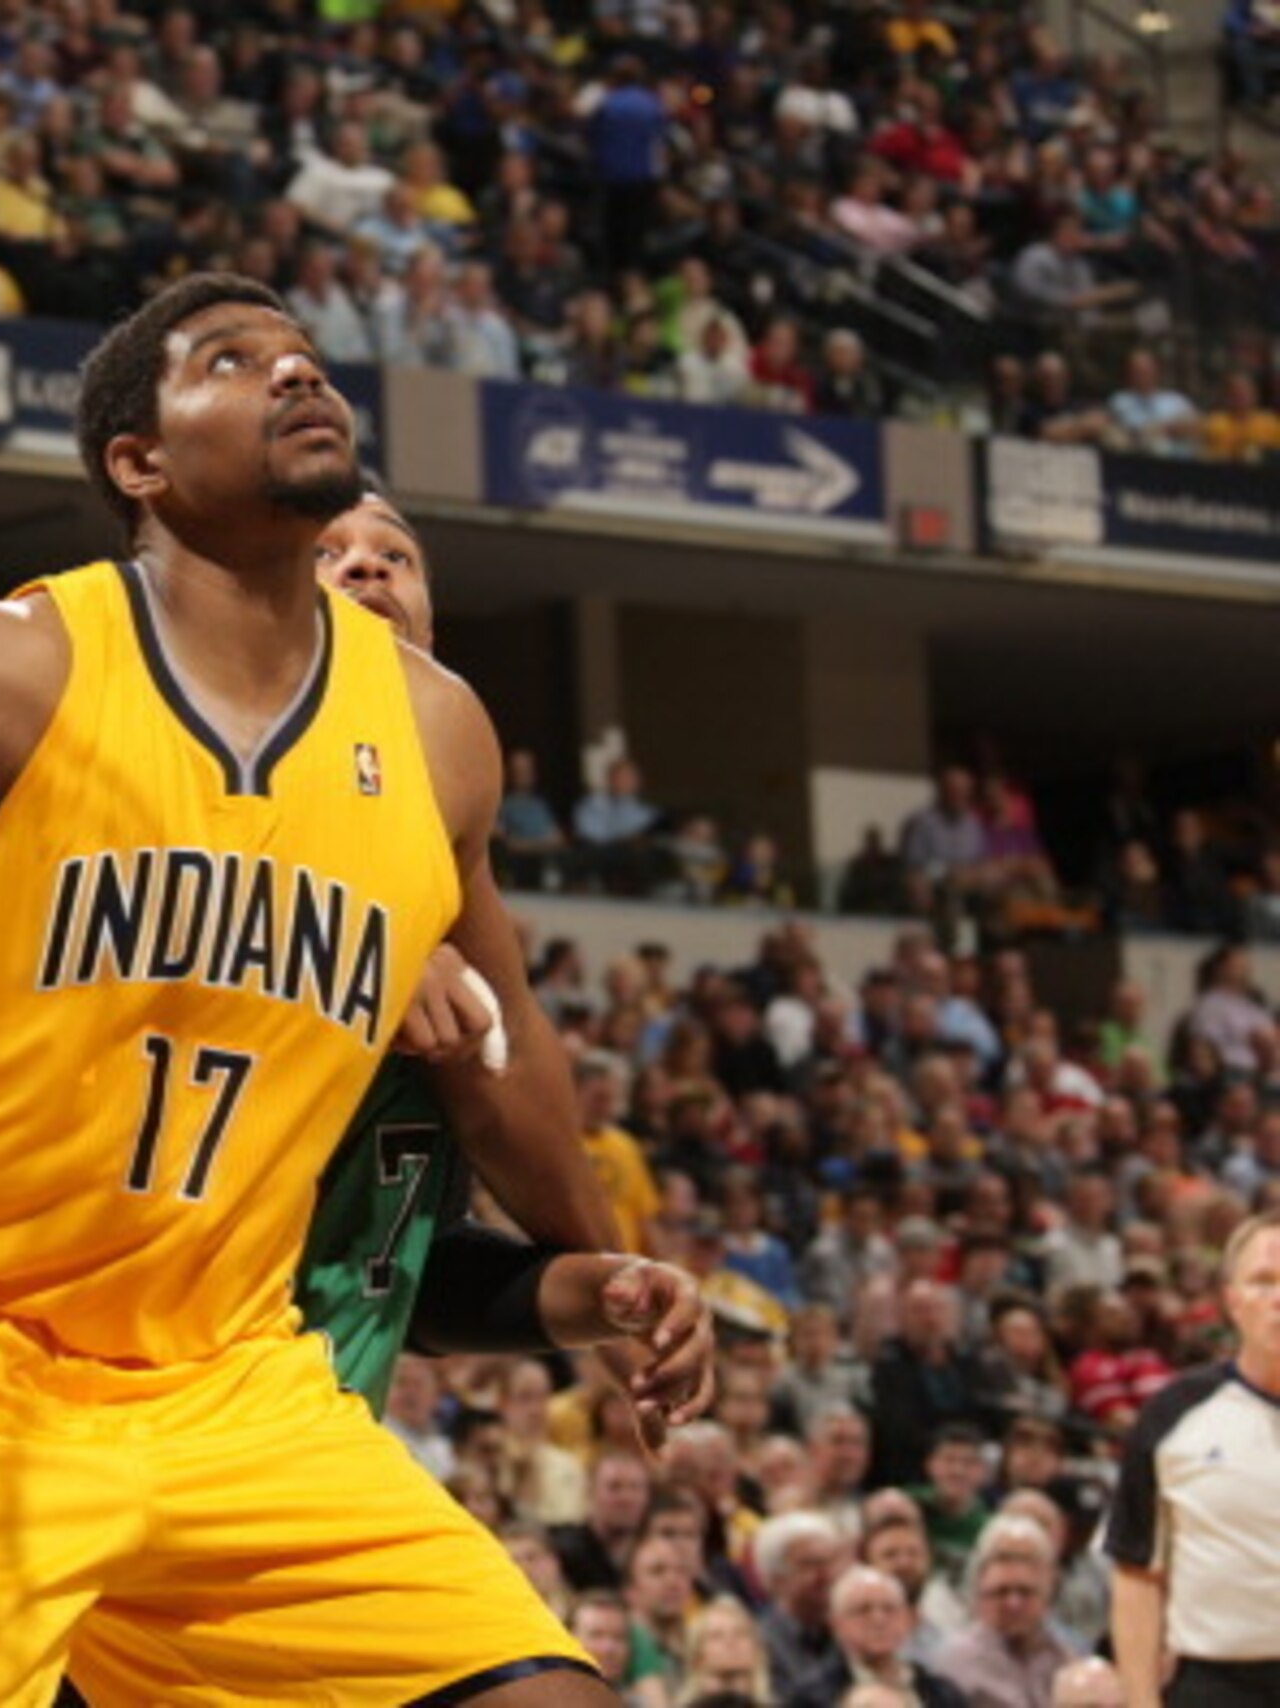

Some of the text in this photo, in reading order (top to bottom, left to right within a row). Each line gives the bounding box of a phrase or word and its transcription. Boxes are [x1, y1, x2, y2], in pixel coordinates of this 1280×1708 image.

[37, 848, 391, 1048] INDIANA
[124, 1031, 259, 1203] 17
[362, 1123, 440, 1298] 7
